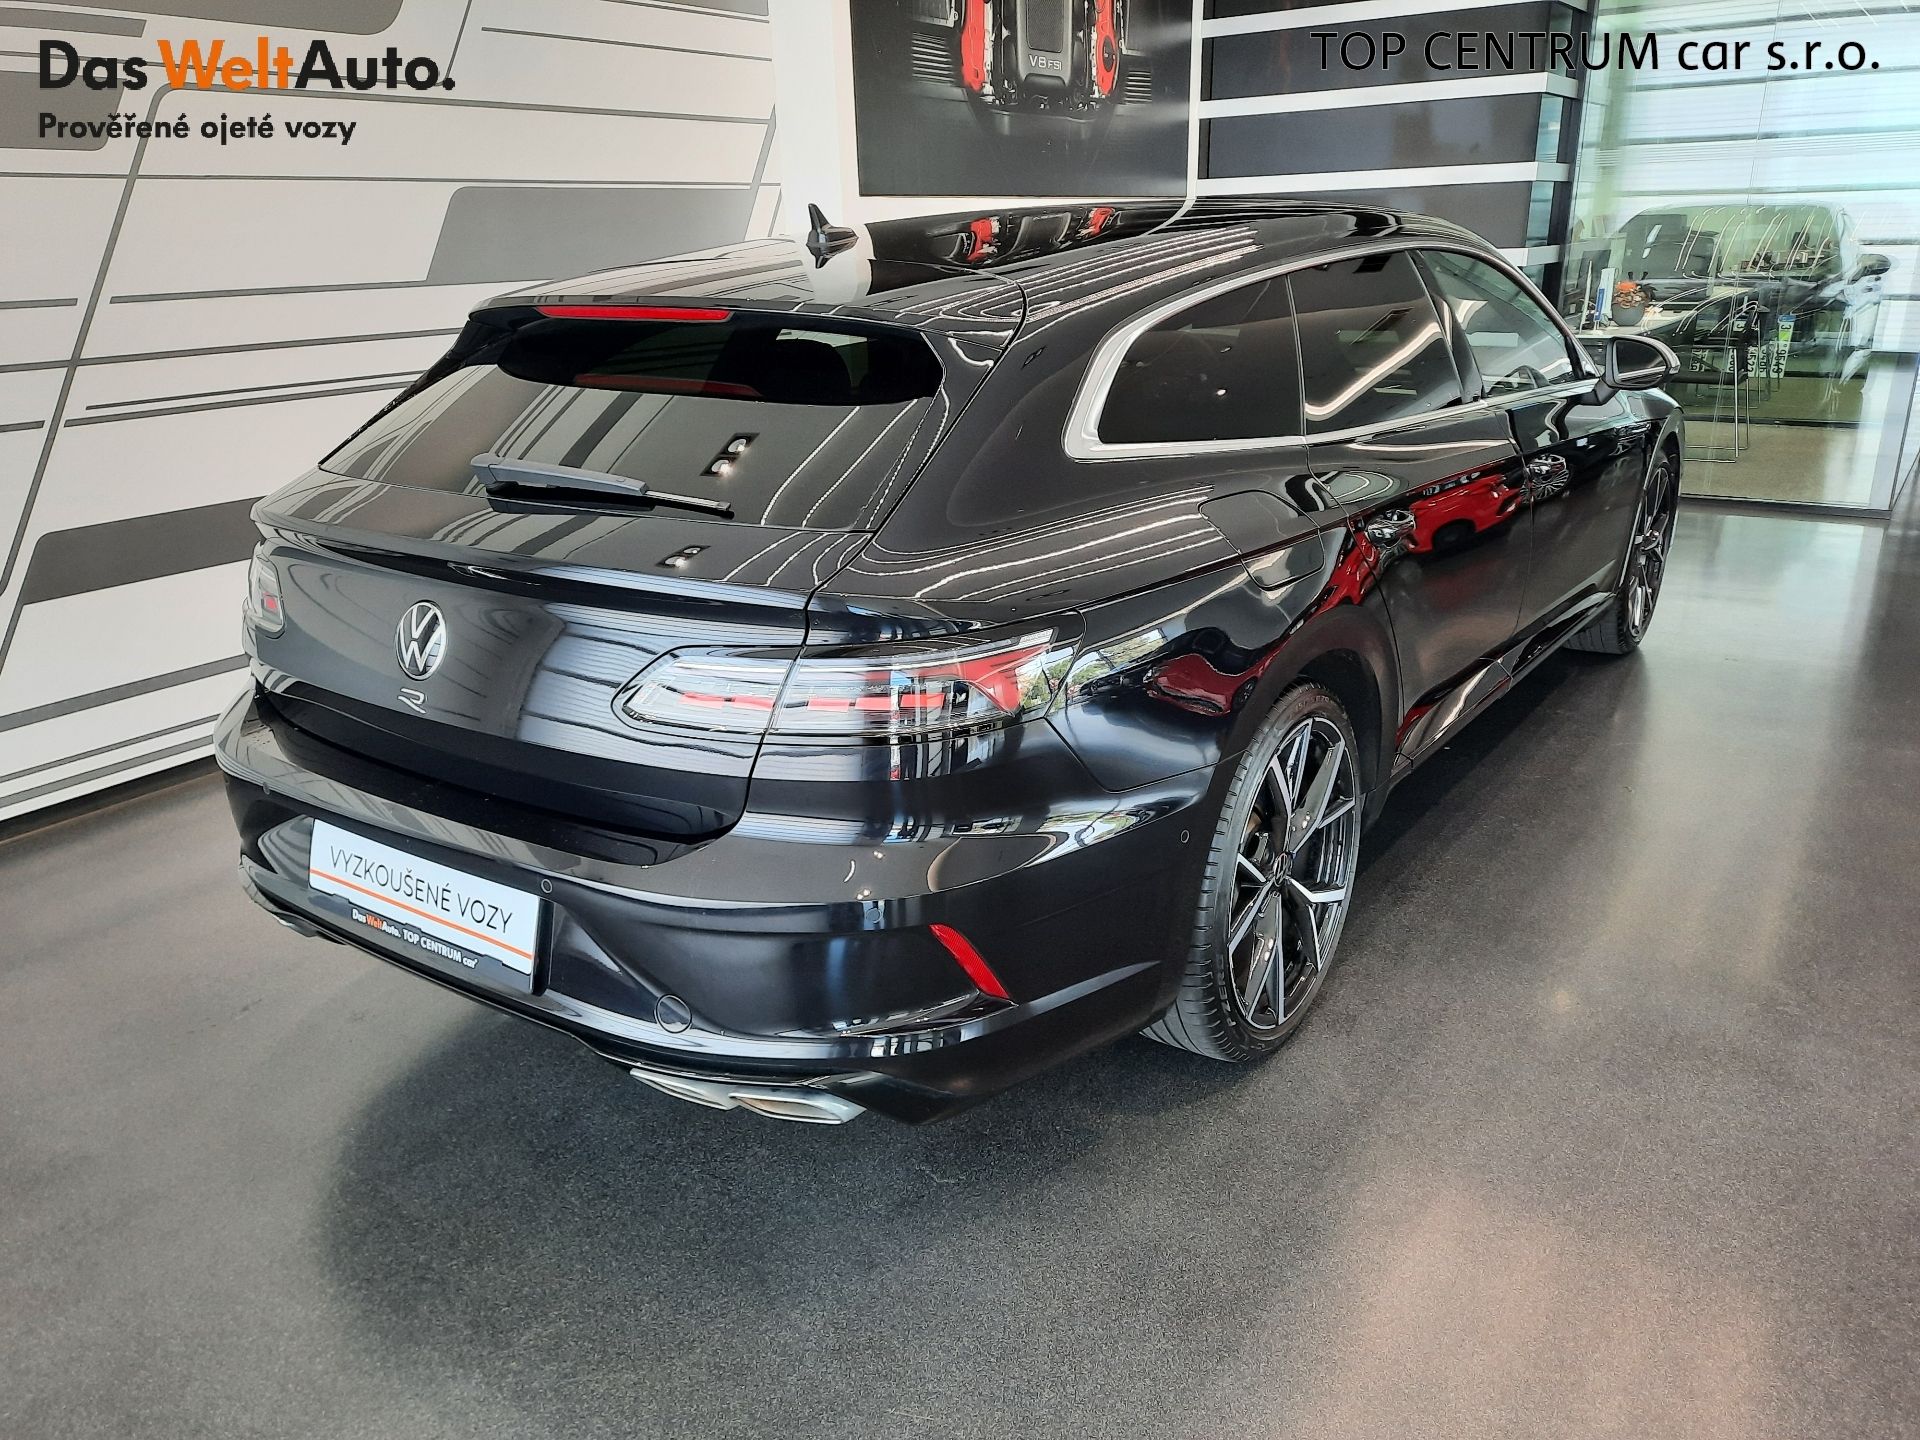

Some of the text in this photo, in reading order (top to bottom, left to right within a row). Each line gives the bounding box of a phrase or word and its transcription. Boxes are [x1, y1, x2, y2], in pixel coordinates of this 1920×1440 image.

[1029, 54, 1046, 68] V8
[330, 845, 513, 934] VYZKOUŠENÉ VOZY
[352, 908, 366, 925] Das
[403, 930, 420, 945] TOP
[420, 936, 462, 963] CENTRUM
